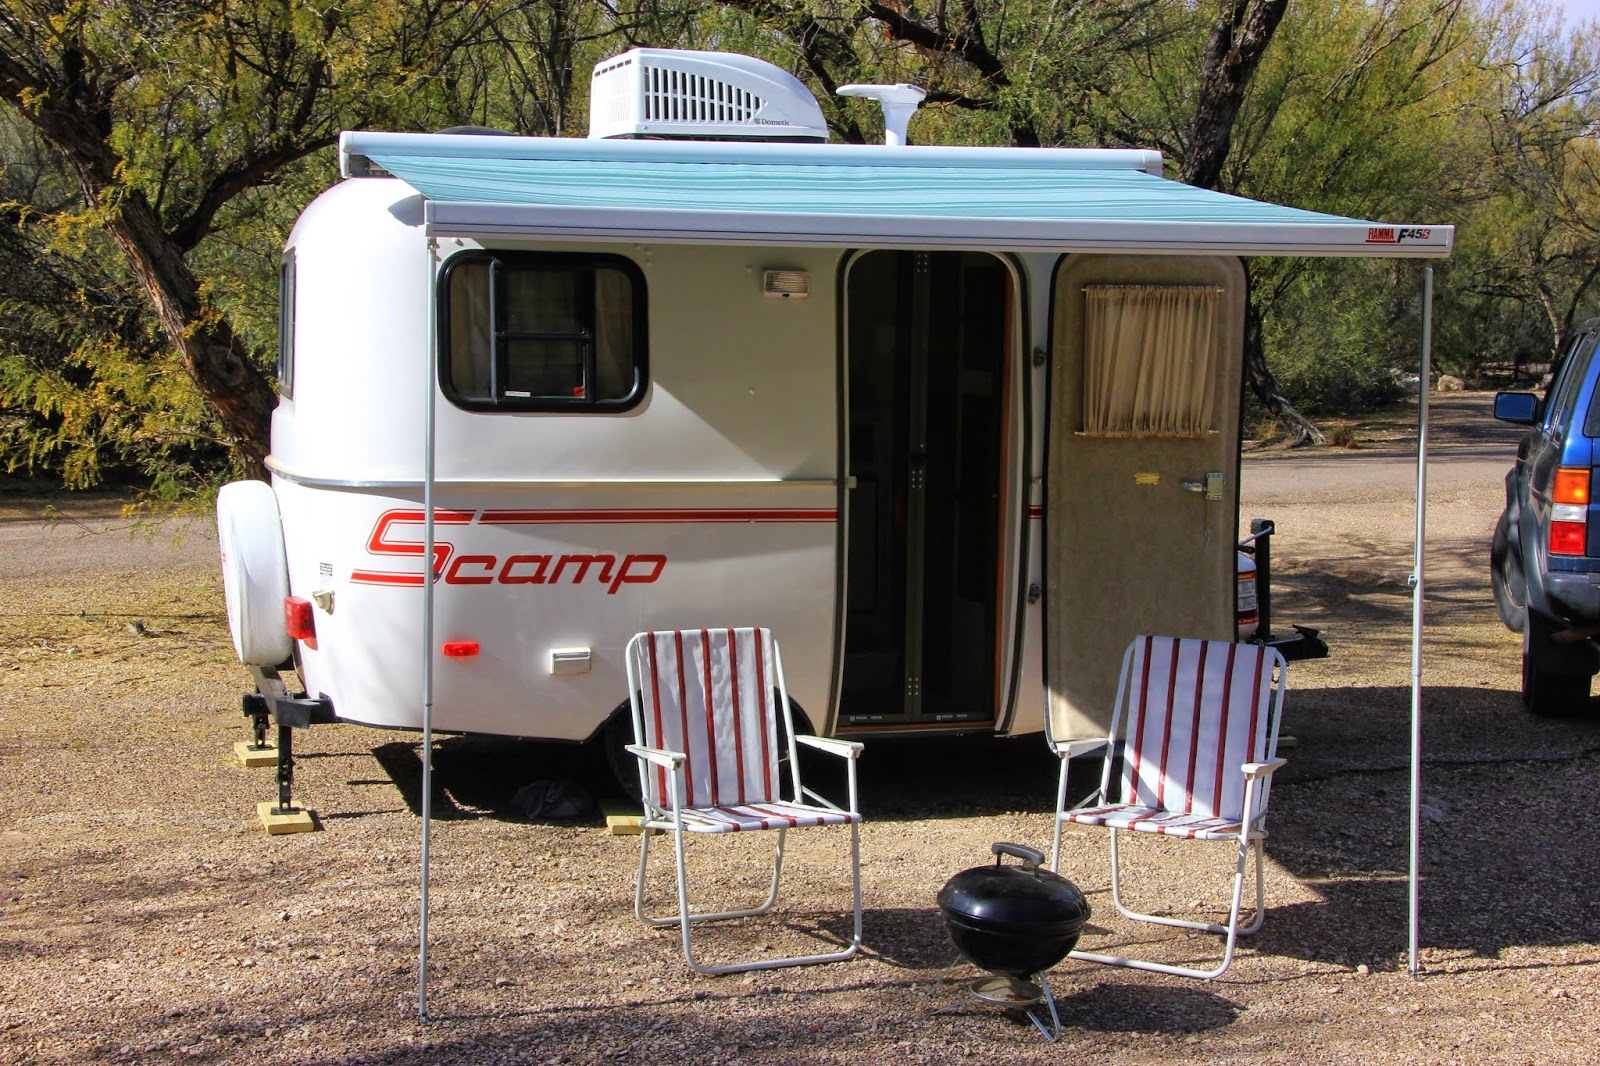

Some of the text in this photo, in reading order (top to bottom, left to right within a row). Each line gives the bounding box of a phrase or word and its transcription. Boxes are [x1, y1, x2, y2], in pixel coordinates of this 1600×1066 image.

[761, 118, 790, 126] Dometic
[1368, 228, 1394, 240] FIAMMA
[349, 508, 667, 595] Scamp
